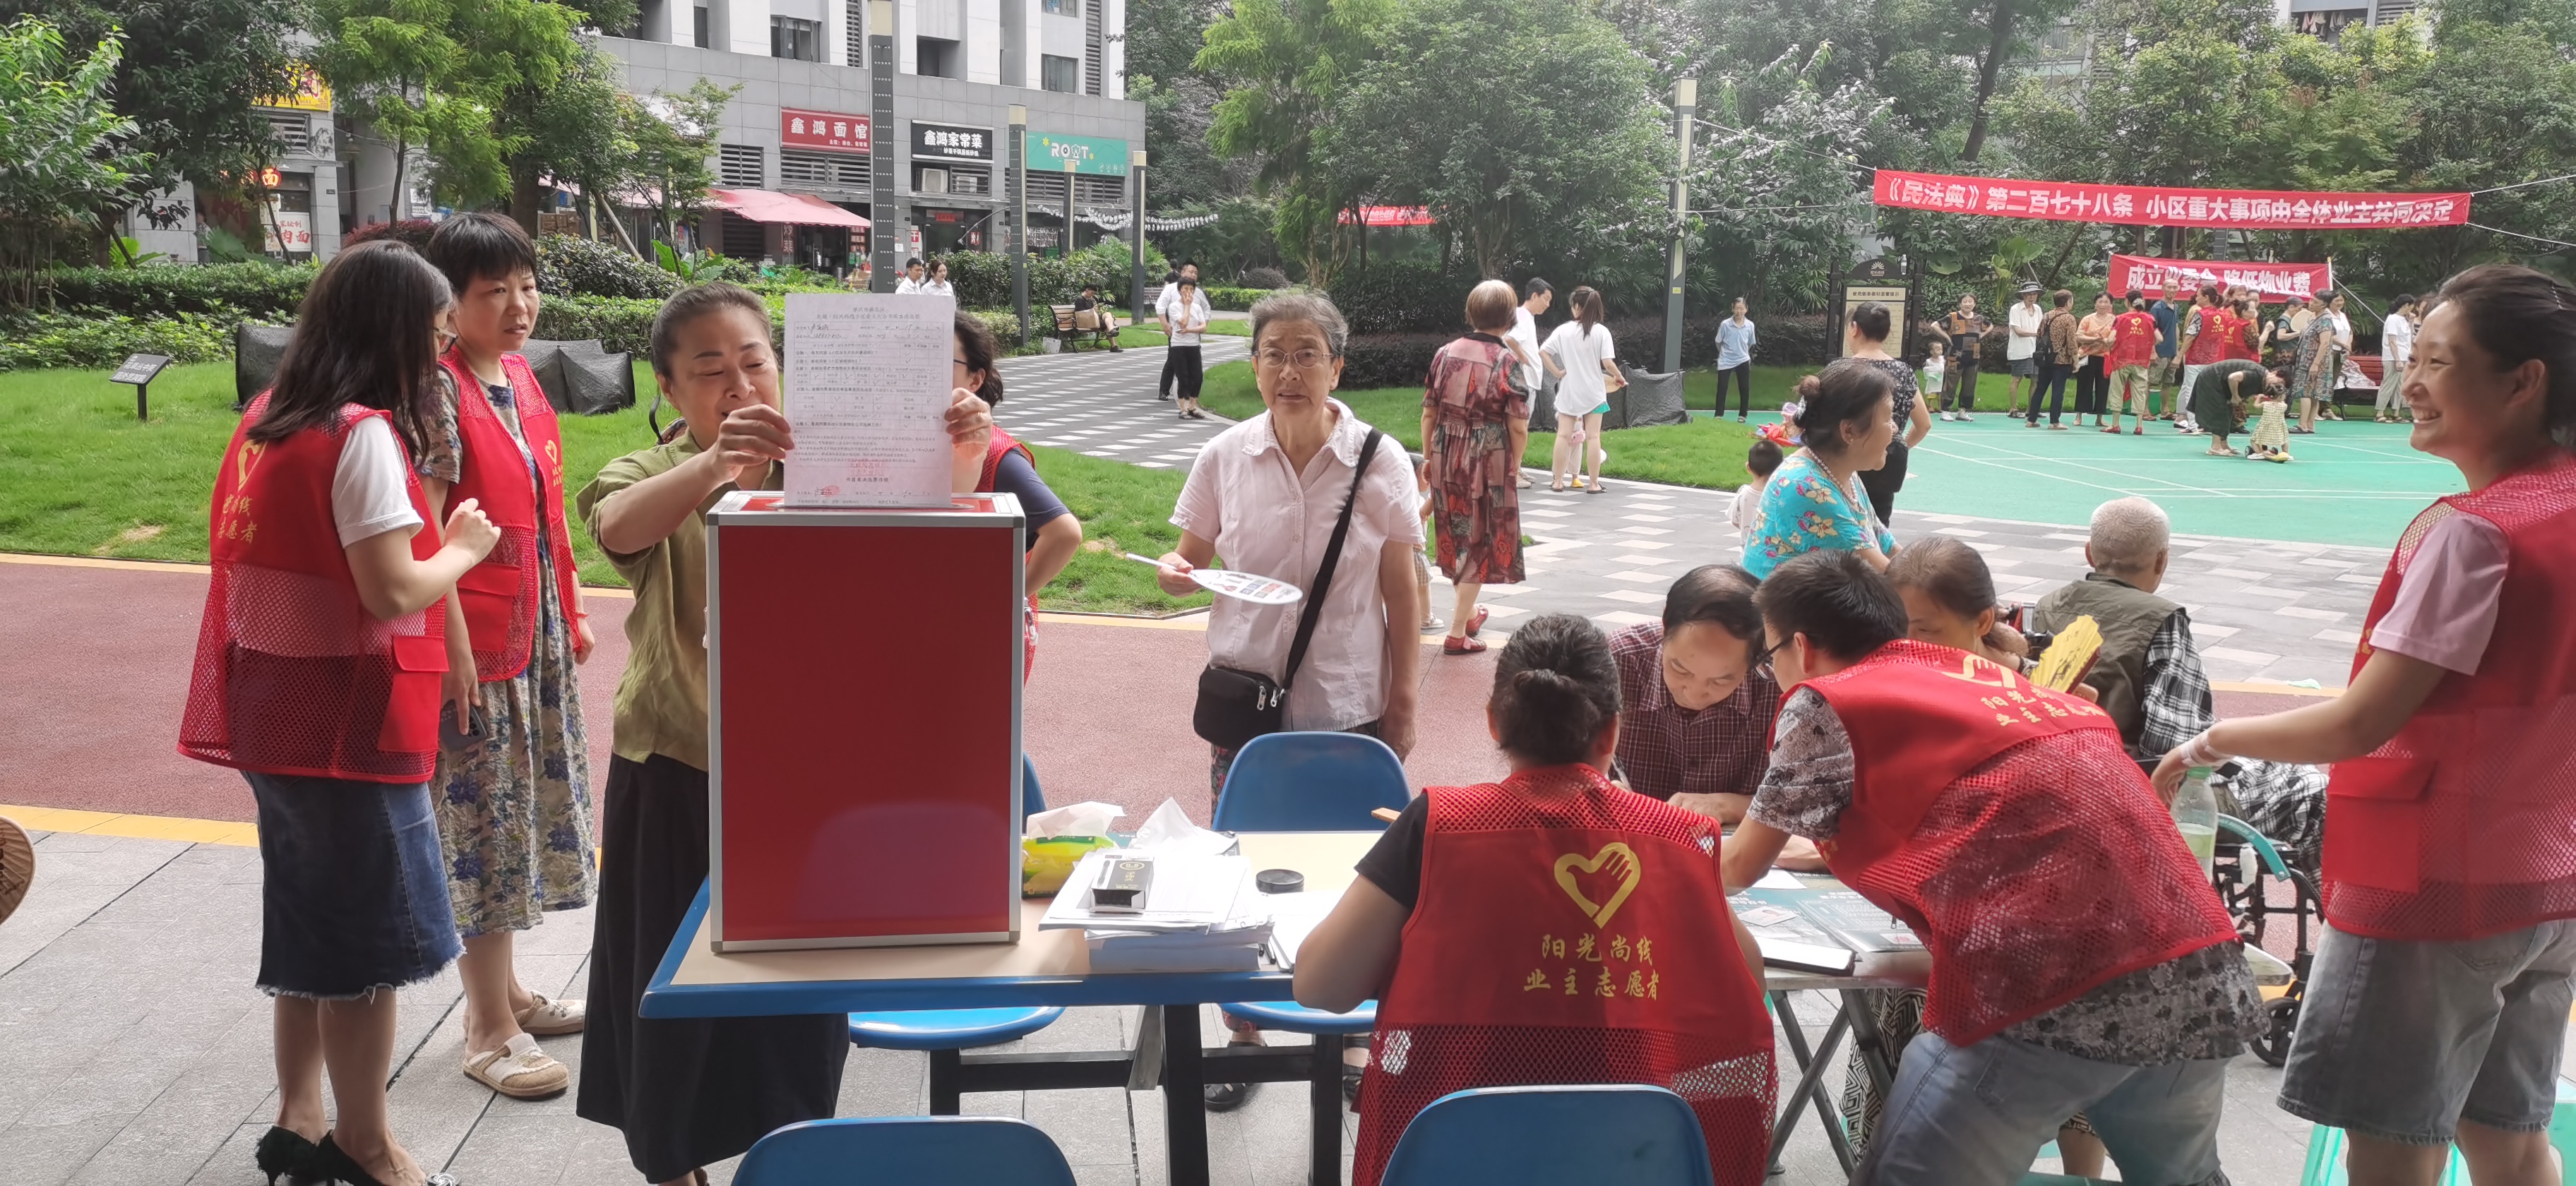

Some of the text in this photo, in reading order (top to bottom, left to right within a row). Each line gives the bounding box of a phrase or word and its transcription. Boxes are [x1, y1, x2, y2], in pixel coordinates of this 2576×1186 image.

[791, 117, 868, 139] 鑫鸿面馆
[924, 130, 982, 148] 鑫鸿家常菜
[1890, 177, 2453, 224] 《民法典》第二百七十八条 小区重大事项由全体业主共同决定
[2224, 269, 2311, 296] 降低物业费
[1542, 933, 1654, 966] 阳光尚线
[1524, 966, 1660, 1001] 业主志愿者
